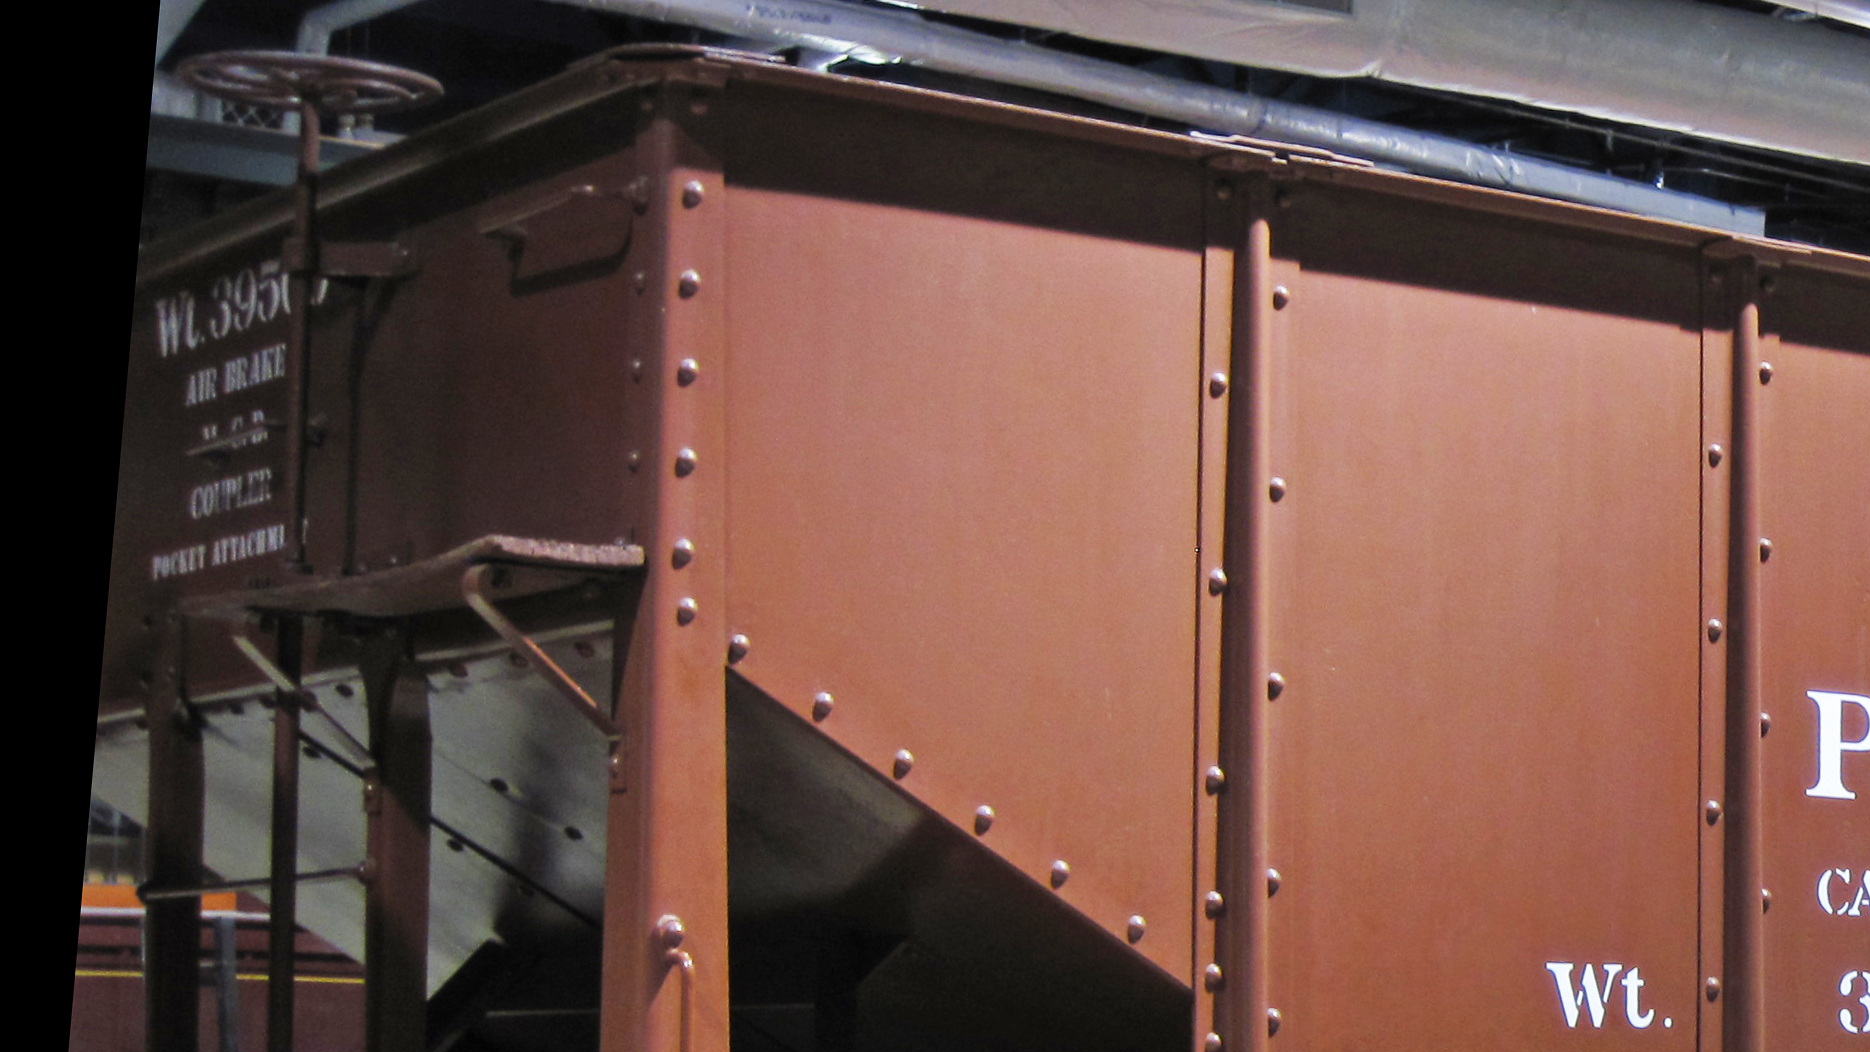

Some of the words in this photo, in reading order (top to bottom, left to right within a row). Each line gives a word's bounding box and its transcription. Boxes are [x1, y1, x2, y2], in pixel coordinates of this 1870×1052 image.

[187, 367, 218, 406] AIR
[224, 343, 287, 394] BRAKE
[152, 544, 206, 581] POCKET
[1544, 961, 1674, 1029] Wt.
